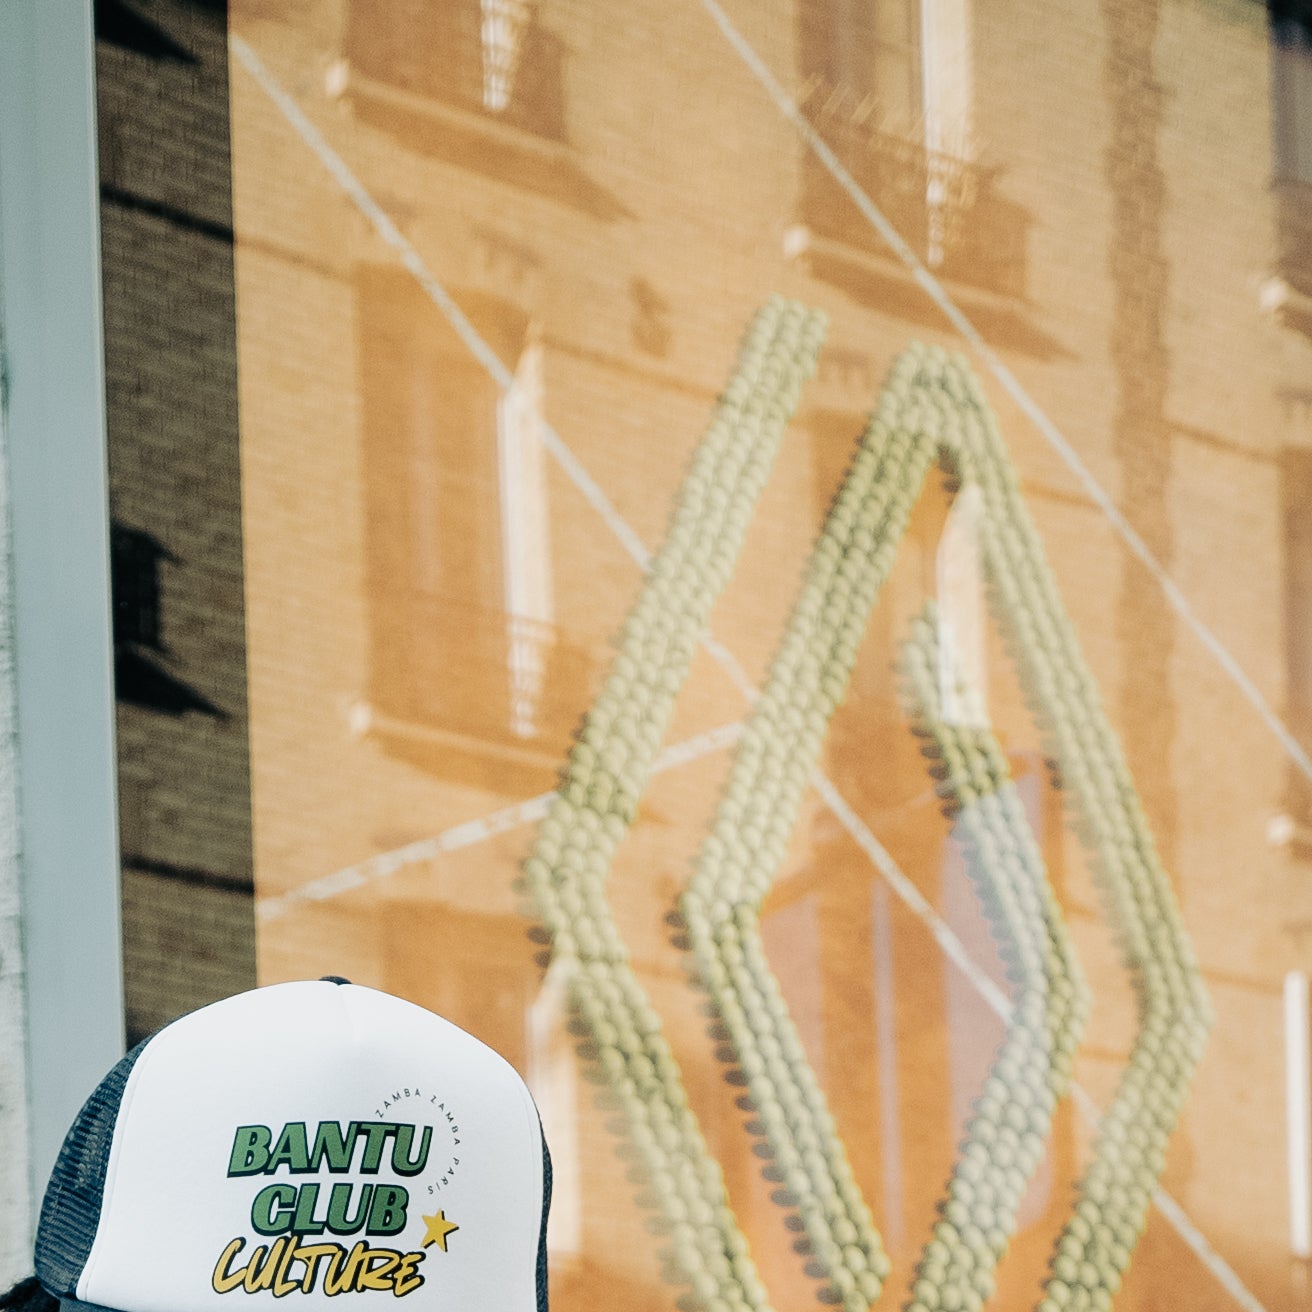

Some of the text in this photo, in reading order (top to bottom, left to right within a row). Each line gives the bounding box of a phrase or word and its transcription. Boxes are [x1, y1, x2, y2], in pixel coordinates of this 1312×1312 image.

[227, 1120, 433, 1178] BANTU
[375, 1088, 461, 1195] ZAMBA ZAMBA PARIS
[250, 1182, 410, 1237] CLUB
[211, 1236, 428, 1298] CULTURE
